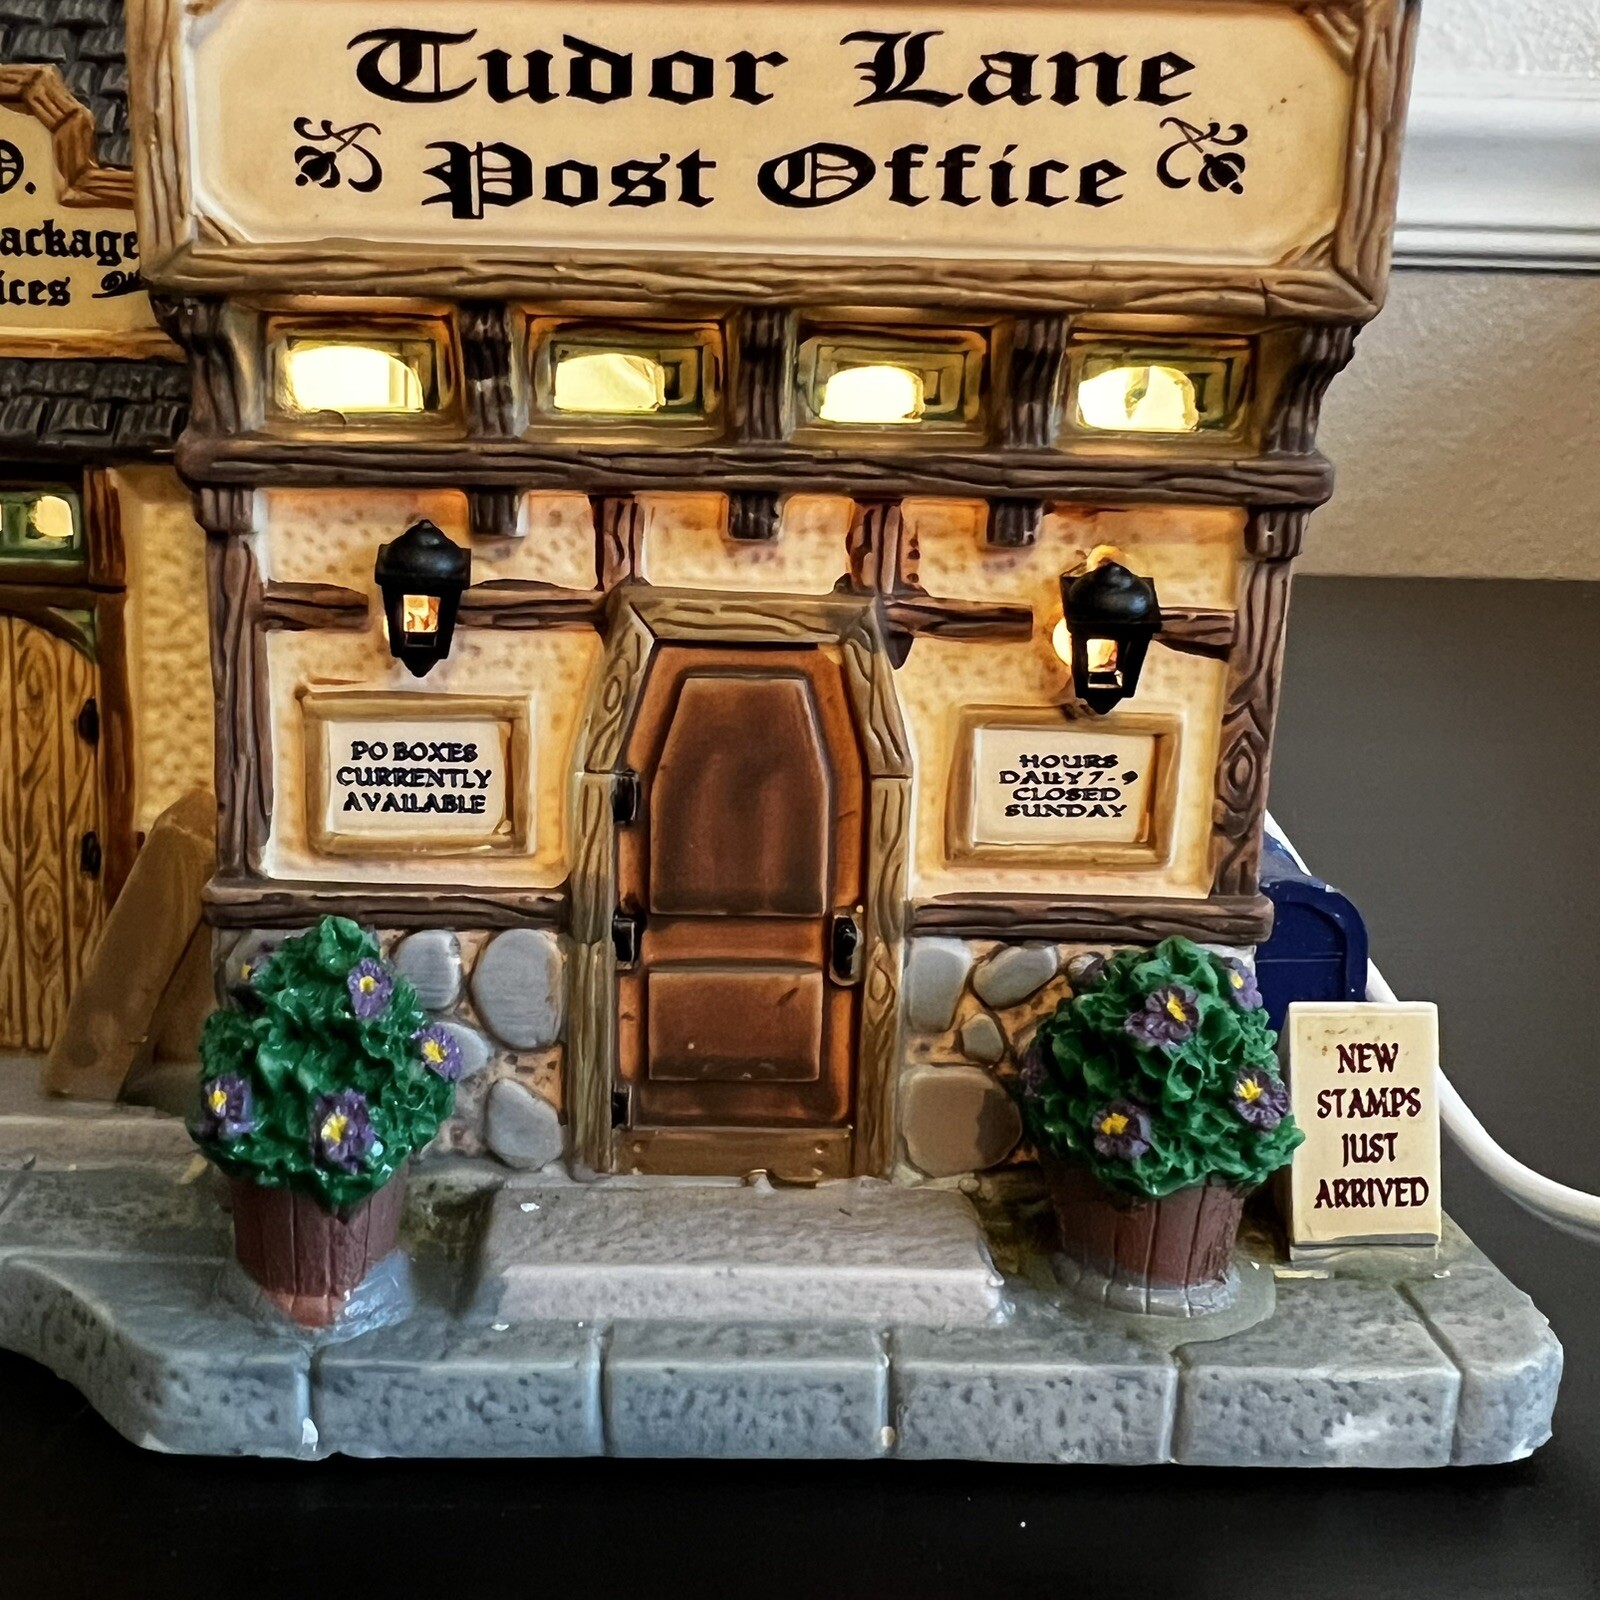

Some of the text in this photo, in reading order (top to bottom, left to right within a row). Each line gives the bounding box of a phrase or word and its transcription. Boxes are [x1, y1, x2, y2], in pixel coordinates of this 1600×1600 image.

[346, 27, 1196, 108] Tudor Lane
[421, 141, 1128, 220] Post Office
[350, 740, 479, 763] PO BOXES
[1018, 754, 1119, 769] HOURS
[335, 766, 493, 789] CURRENTLY
[998, 770, 1084, 785] DAILY
[342, 791, 487, 815] AVAILABLE
[1012, 786, 1122, 802] CLOSED
[1004, 803, 1128, 818] SUNDAY
[1335, 1042, 1399, 1074] NEW
[1316, 1087, 1422, 1119] STAMPS
[1341, 1132, 1399, 1168] JUST
[1313, 1176, 1430, 1209] ARRIVED
